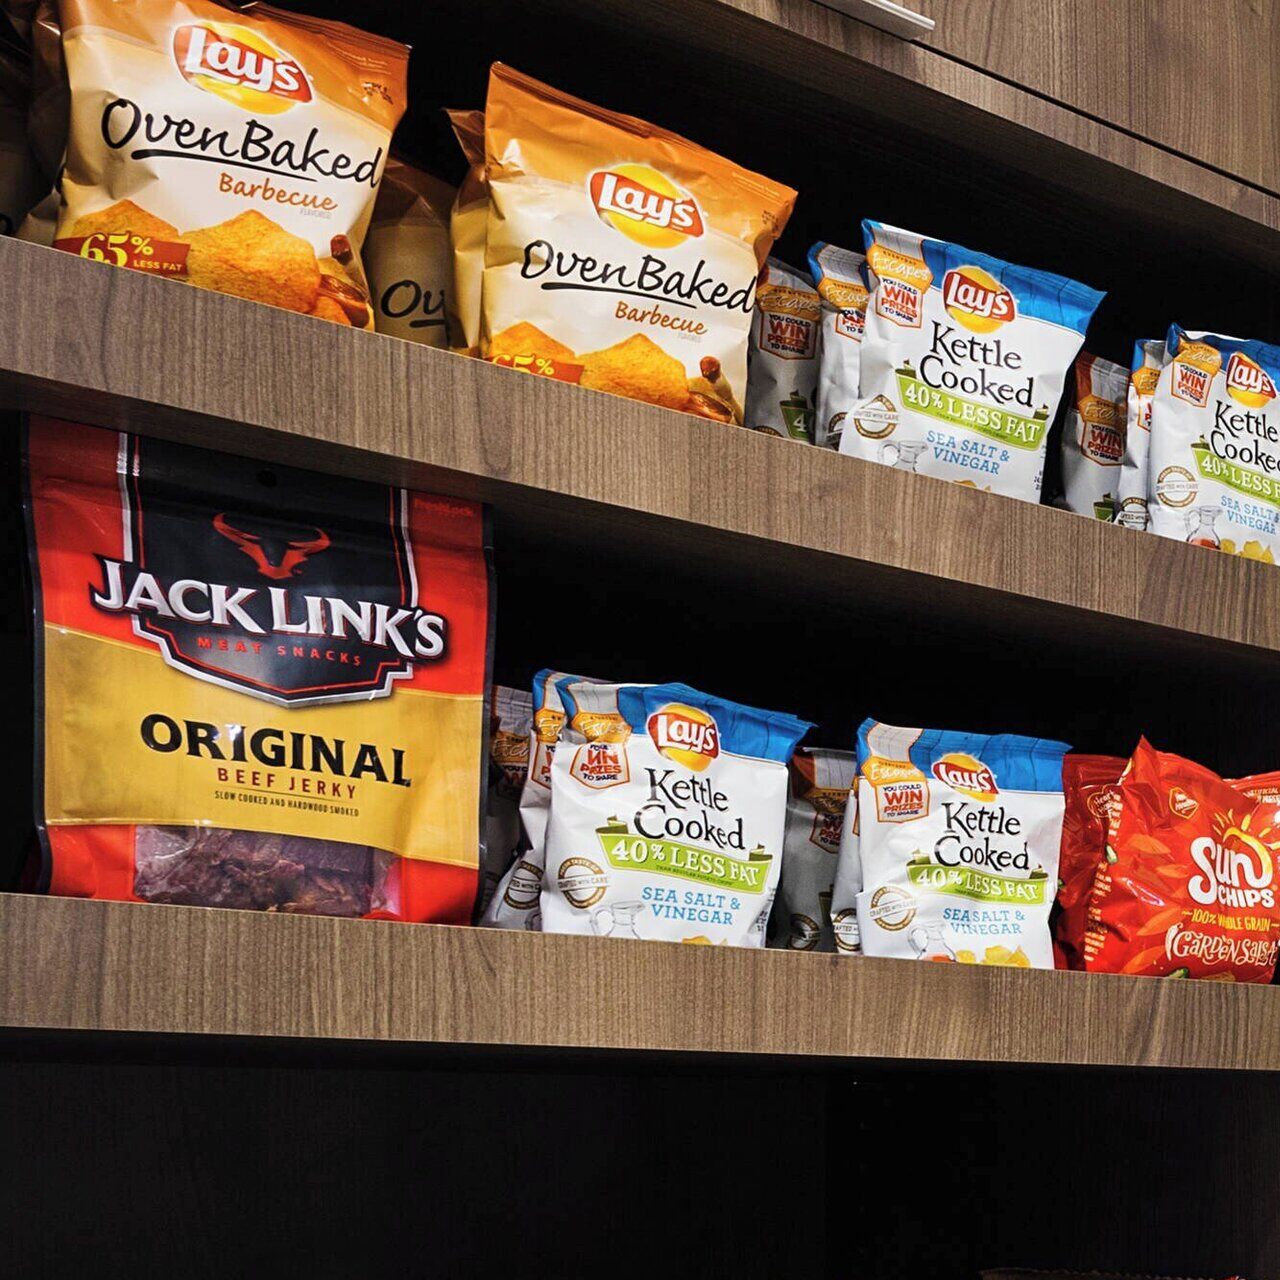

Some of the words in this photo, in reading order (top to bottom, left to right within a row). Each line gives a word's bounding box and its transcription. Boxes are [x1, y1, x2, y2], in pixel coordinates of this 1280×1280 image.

[185, 26, 301, 92] Lay's
[219, 173, 338, 211] Barbecue
[597, 175, 696, 231] Lay's
[615, 300, 707, 335] Barbecue
[930, 321, 1022, 371] Kettle
[919, 354, 1035, 408] Cooked
[1214, 400, 1278, 443] Kettle
[933, 447, 1001, 476] VINEGAR
[94, 558, 266, 634] JACK
[268, 586, 447, 658] LINK'S
[197, 636, 262, 655] MEAT
[277, 644, 362, 667] SNACKS
[140, 713, 412, 788] ORIGINAL
[217, 767, 277, 789] BEEF
[288, 774, 357, 800] JERKY
[644, 767, 729, 812] Kettle
[215, 790, 235, 801] SLOW
[238, 792, 268, 806] COOKED
[270, 796, 286, 808] AND
[287, 798, 328, 814] HARDWOOD
[329, 803, 360, 818] SMOKED
[941, 802, 1020, 839] Kettle
[634, 803, 745, 850] Cooked
[934, 835, 1029, 871] Cooked
[651, 903, 733, 926] VINEGAR
[1217, 888, 1275, 909] CHIPS
[950, 922, 1022, 936] VINEGAR
[1192, 908, 1217, 925] 100%
[1218, 914, 1244, 931] WHOLE
[1244, 916, 1272, 932] GRAIN
